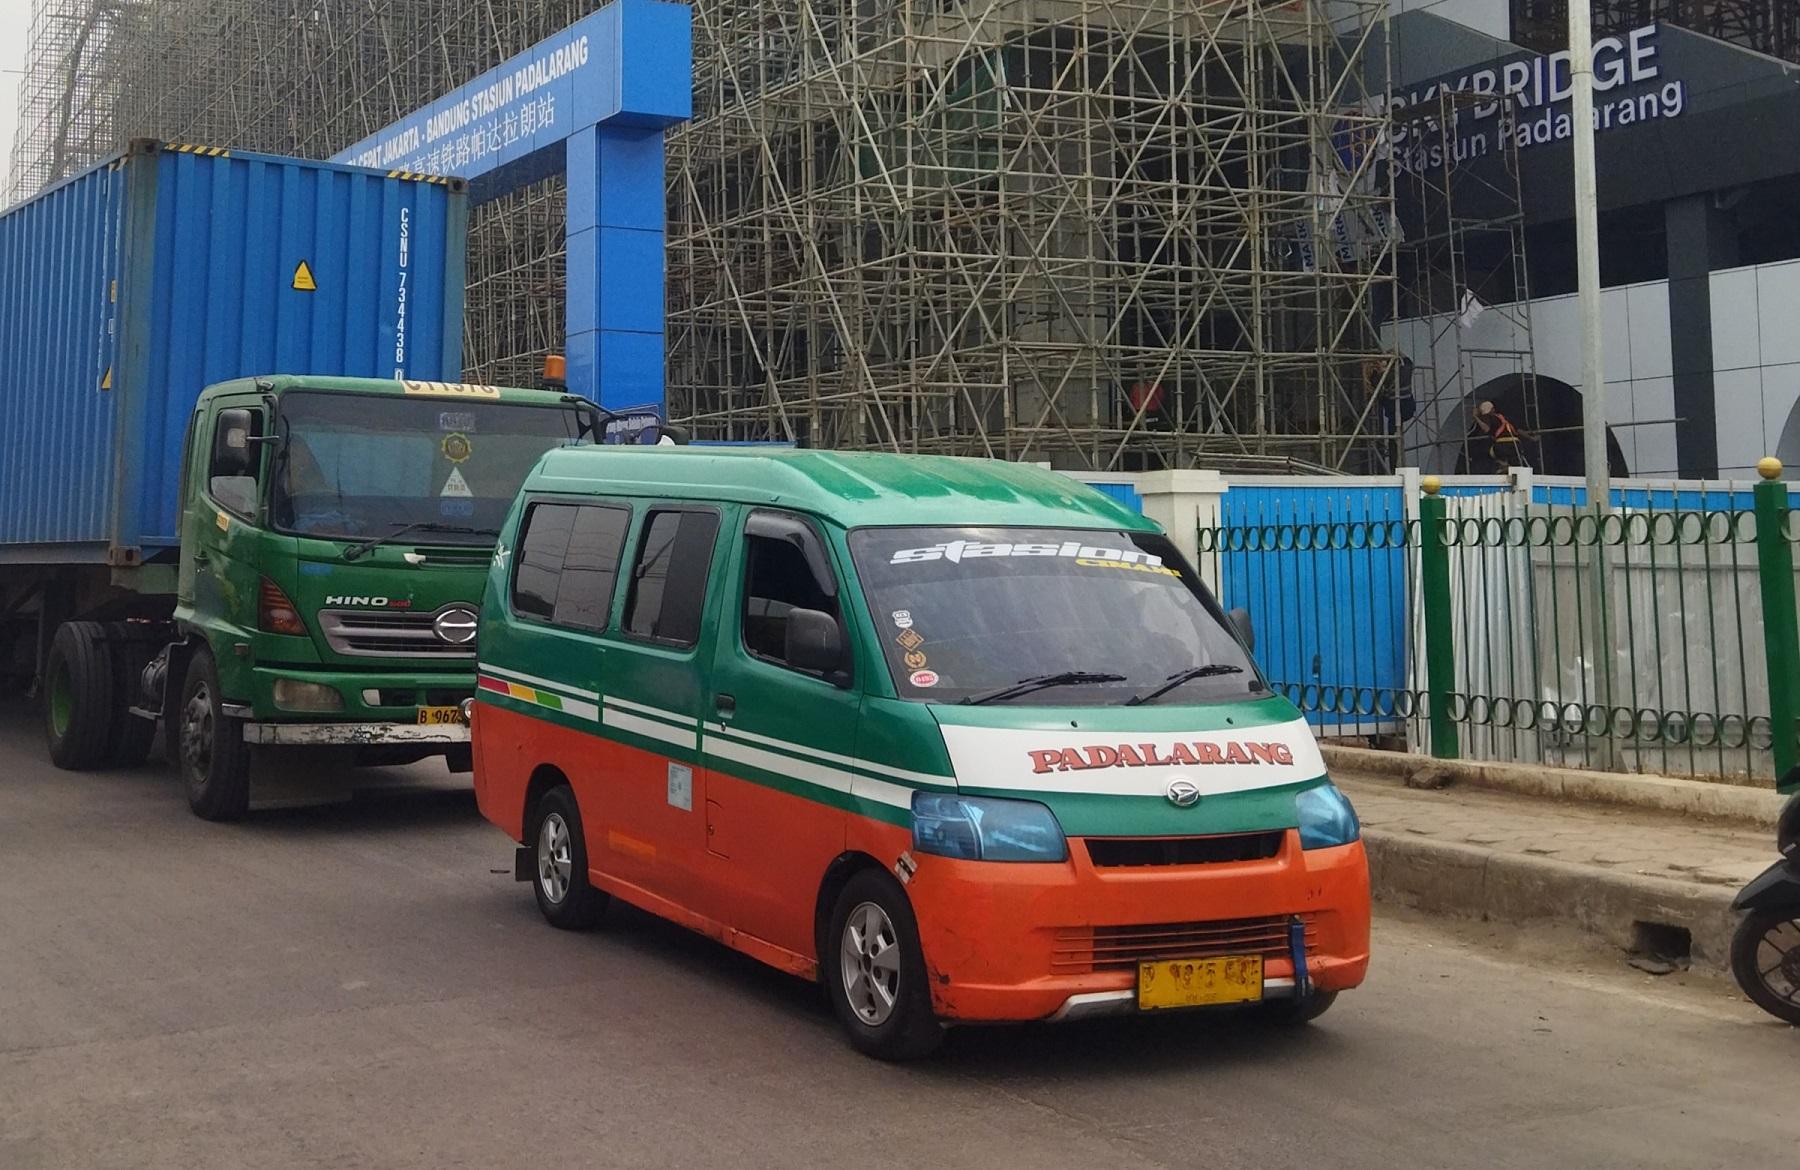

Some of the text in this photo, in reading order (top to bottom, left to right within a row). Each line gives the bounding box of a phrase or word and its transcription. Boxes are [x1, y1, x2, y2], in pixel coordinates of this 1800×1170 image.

[383, 126, 420, 165] JAKARTA
[426, 99, 470, 143] BANDUNG
[471, 75, 513, 120] STASIUN
[515, 35, 589, 98] PADALARANG
[399, 207, 409, 268] CSNU
[395, 272, 407, 363] 734438
[889, 540, 1163, 567] stasion
[325, 595, 388, 606] HINO
[419, 709, 428, 724] B
[1028, 741, 1294, 774] PADALARANG
